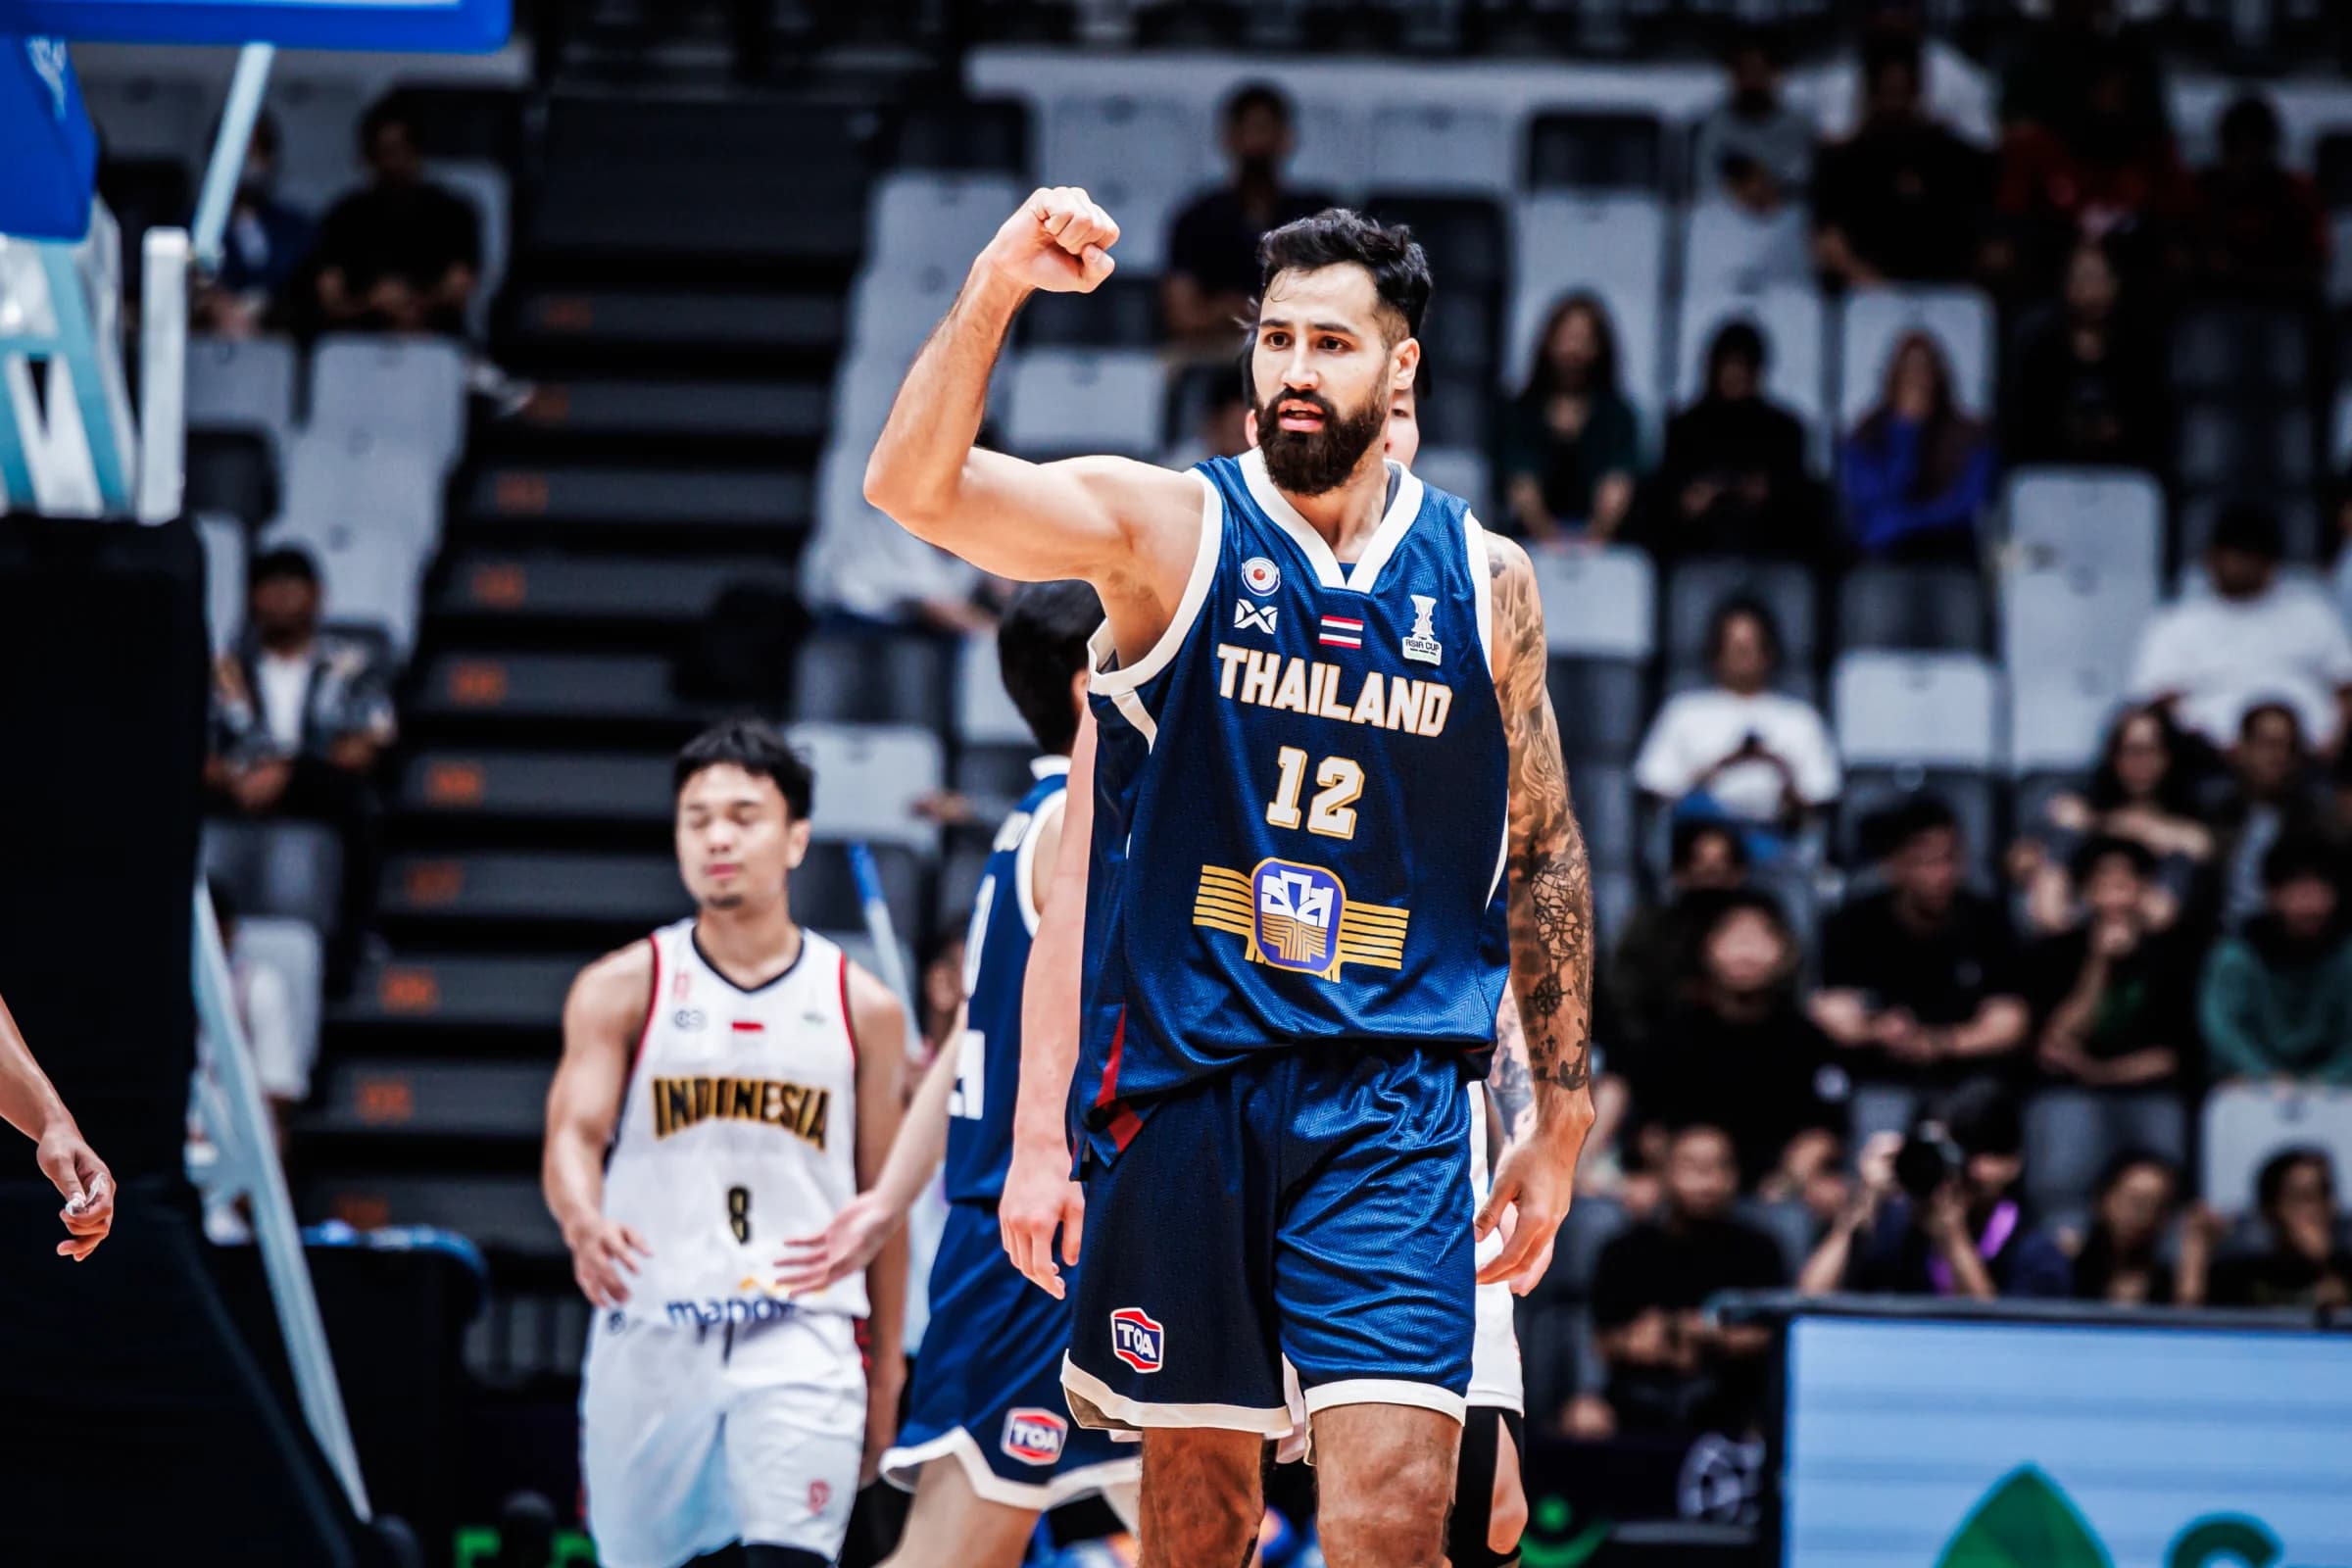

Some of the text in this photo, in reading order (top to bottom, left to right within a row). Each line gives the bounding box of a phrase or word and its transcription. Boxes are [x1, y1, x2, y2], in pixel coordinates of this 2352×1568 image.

[1405, 638, 1424, 649] ASIA
[1425, 642, 1440, 652] CUP
[1217, 643, 1452, 737] THAILAND
[1266, 746, 1365, 840] 12
[654, 1075, 830, 1152] INDONESIA
[727, 1186, 751, 1245] 8
[1116, 1323, 1156, 1359] TOA
[1012, 1423, 1060, 1454] TOA
